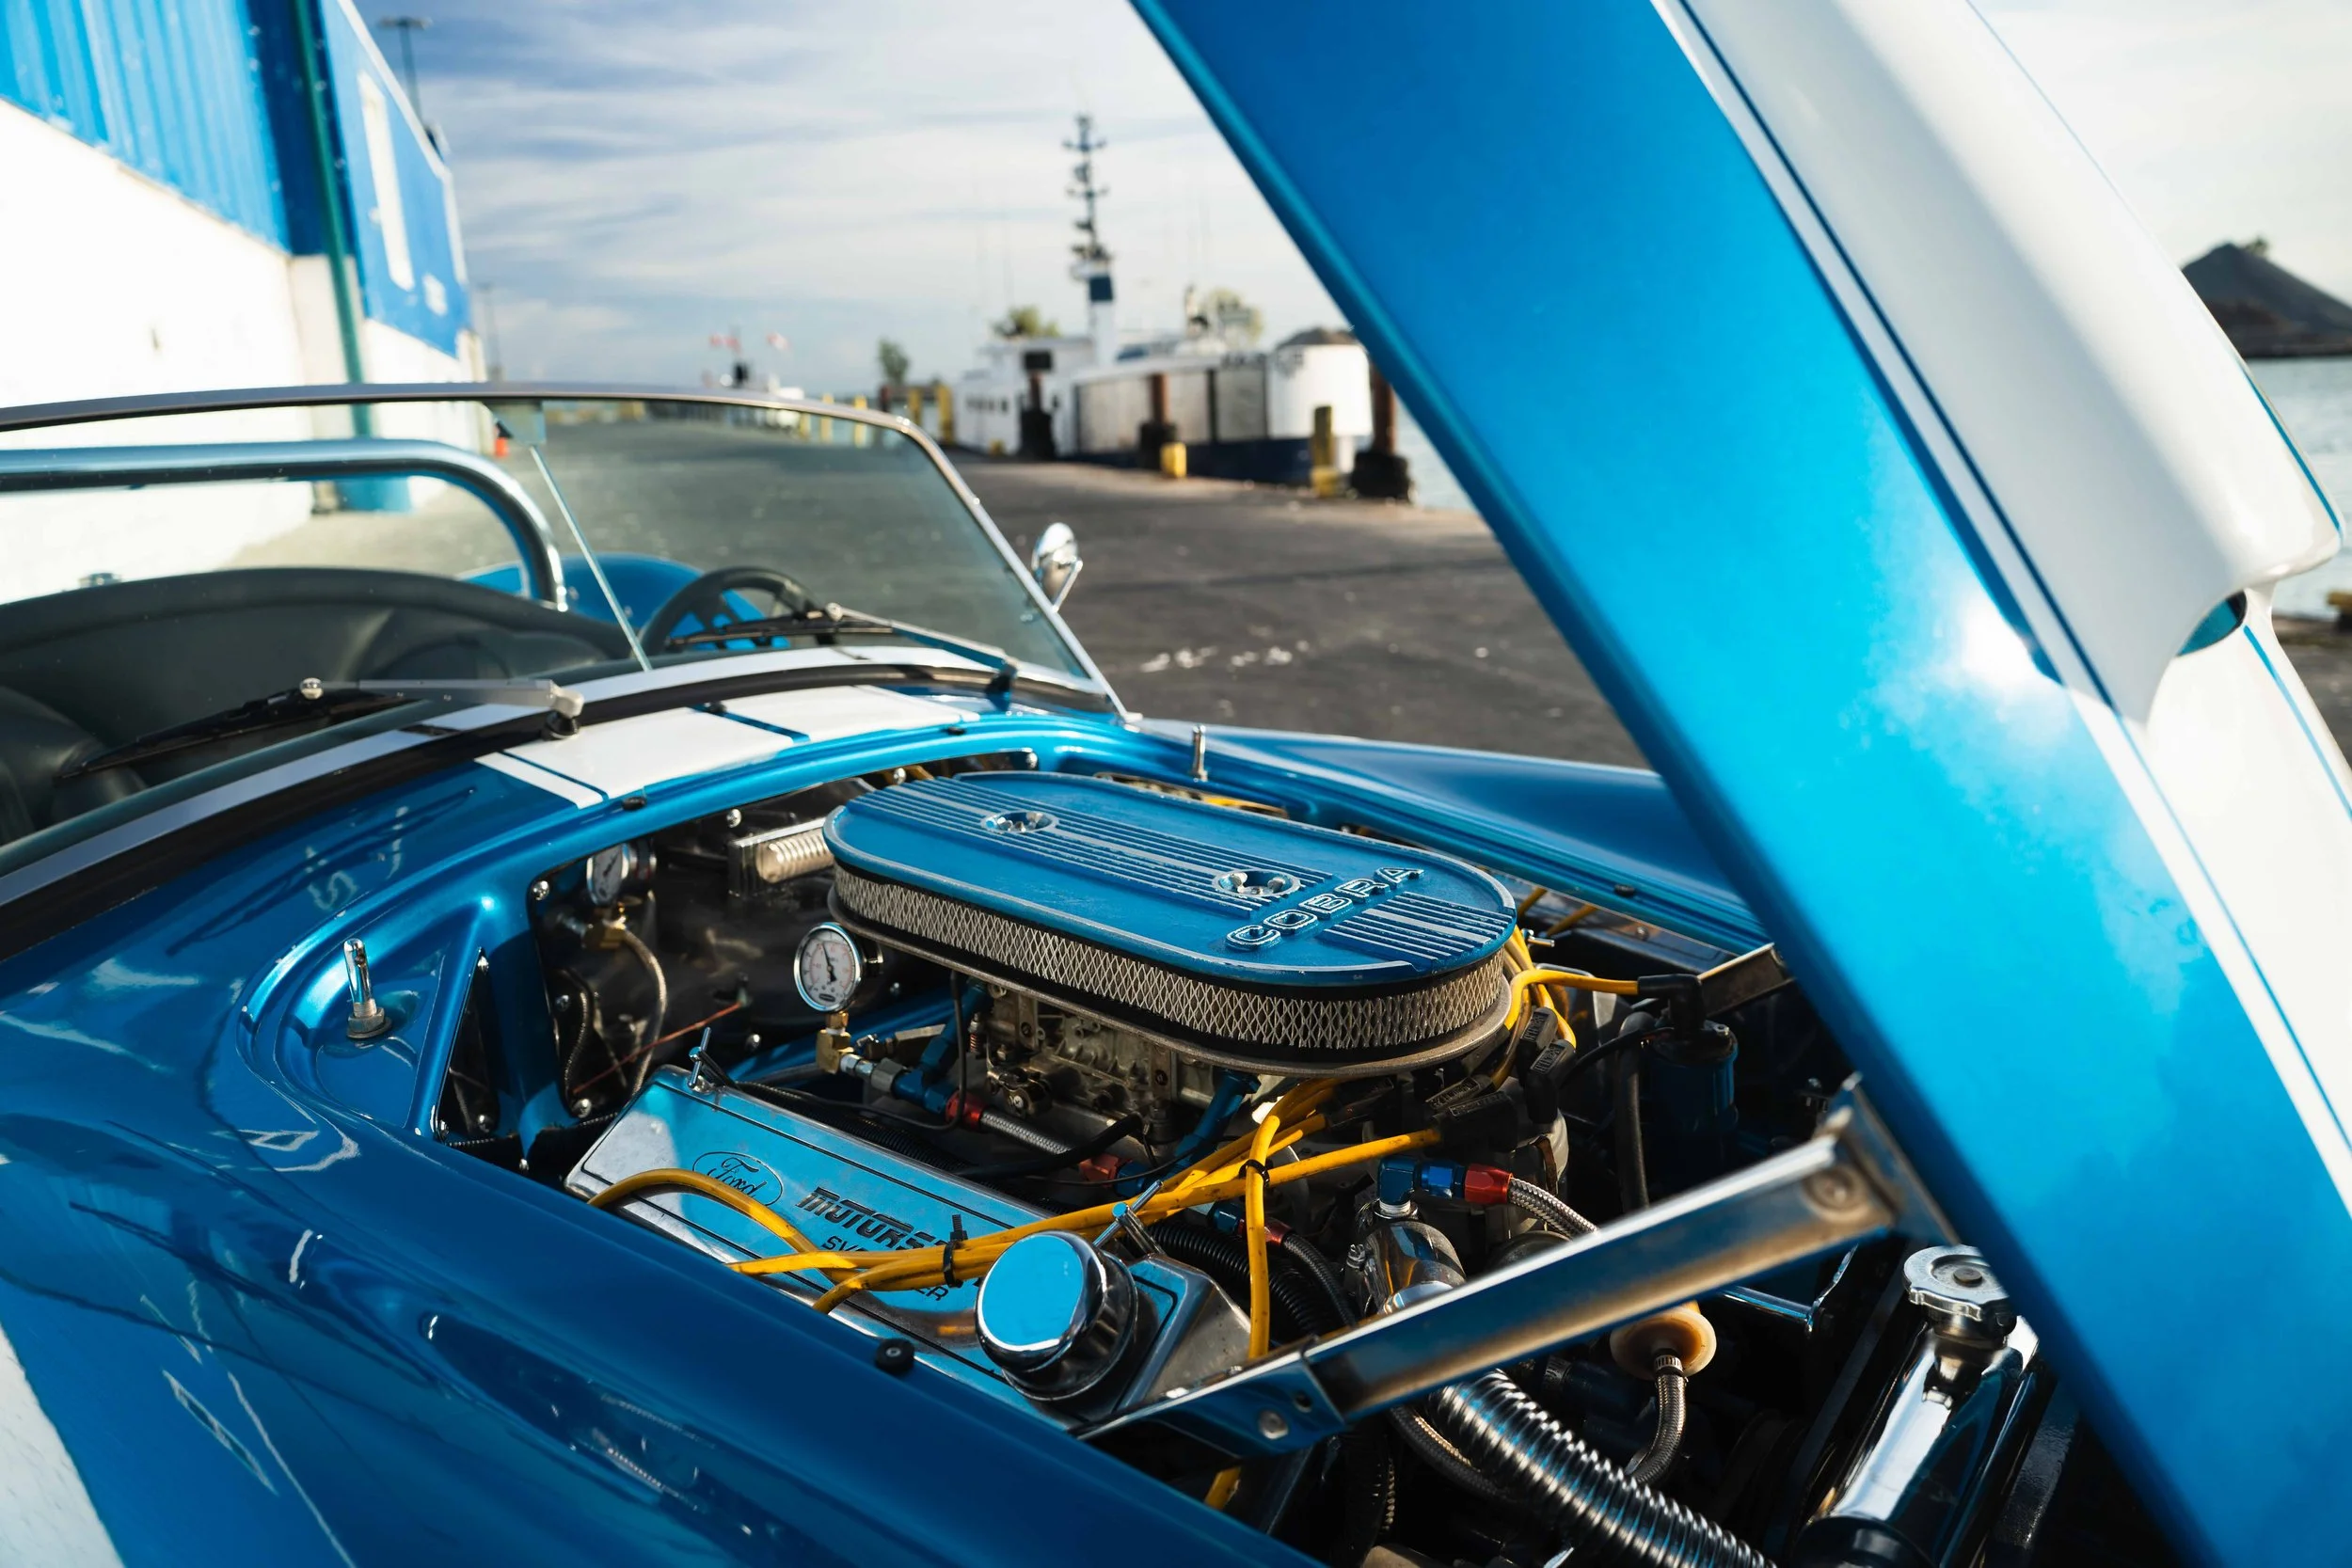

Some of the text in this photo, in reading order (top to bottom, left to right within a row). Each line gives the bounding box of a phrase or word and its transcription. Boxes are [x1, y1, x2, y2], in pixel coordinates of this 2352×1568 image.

[1226, 866, 1424, 950] COBRA
[707, 1156, 768, 1197] Ford
[796, 1186, 948, 1251] MOTORS
[820, 1235, 869, 1252] SV
